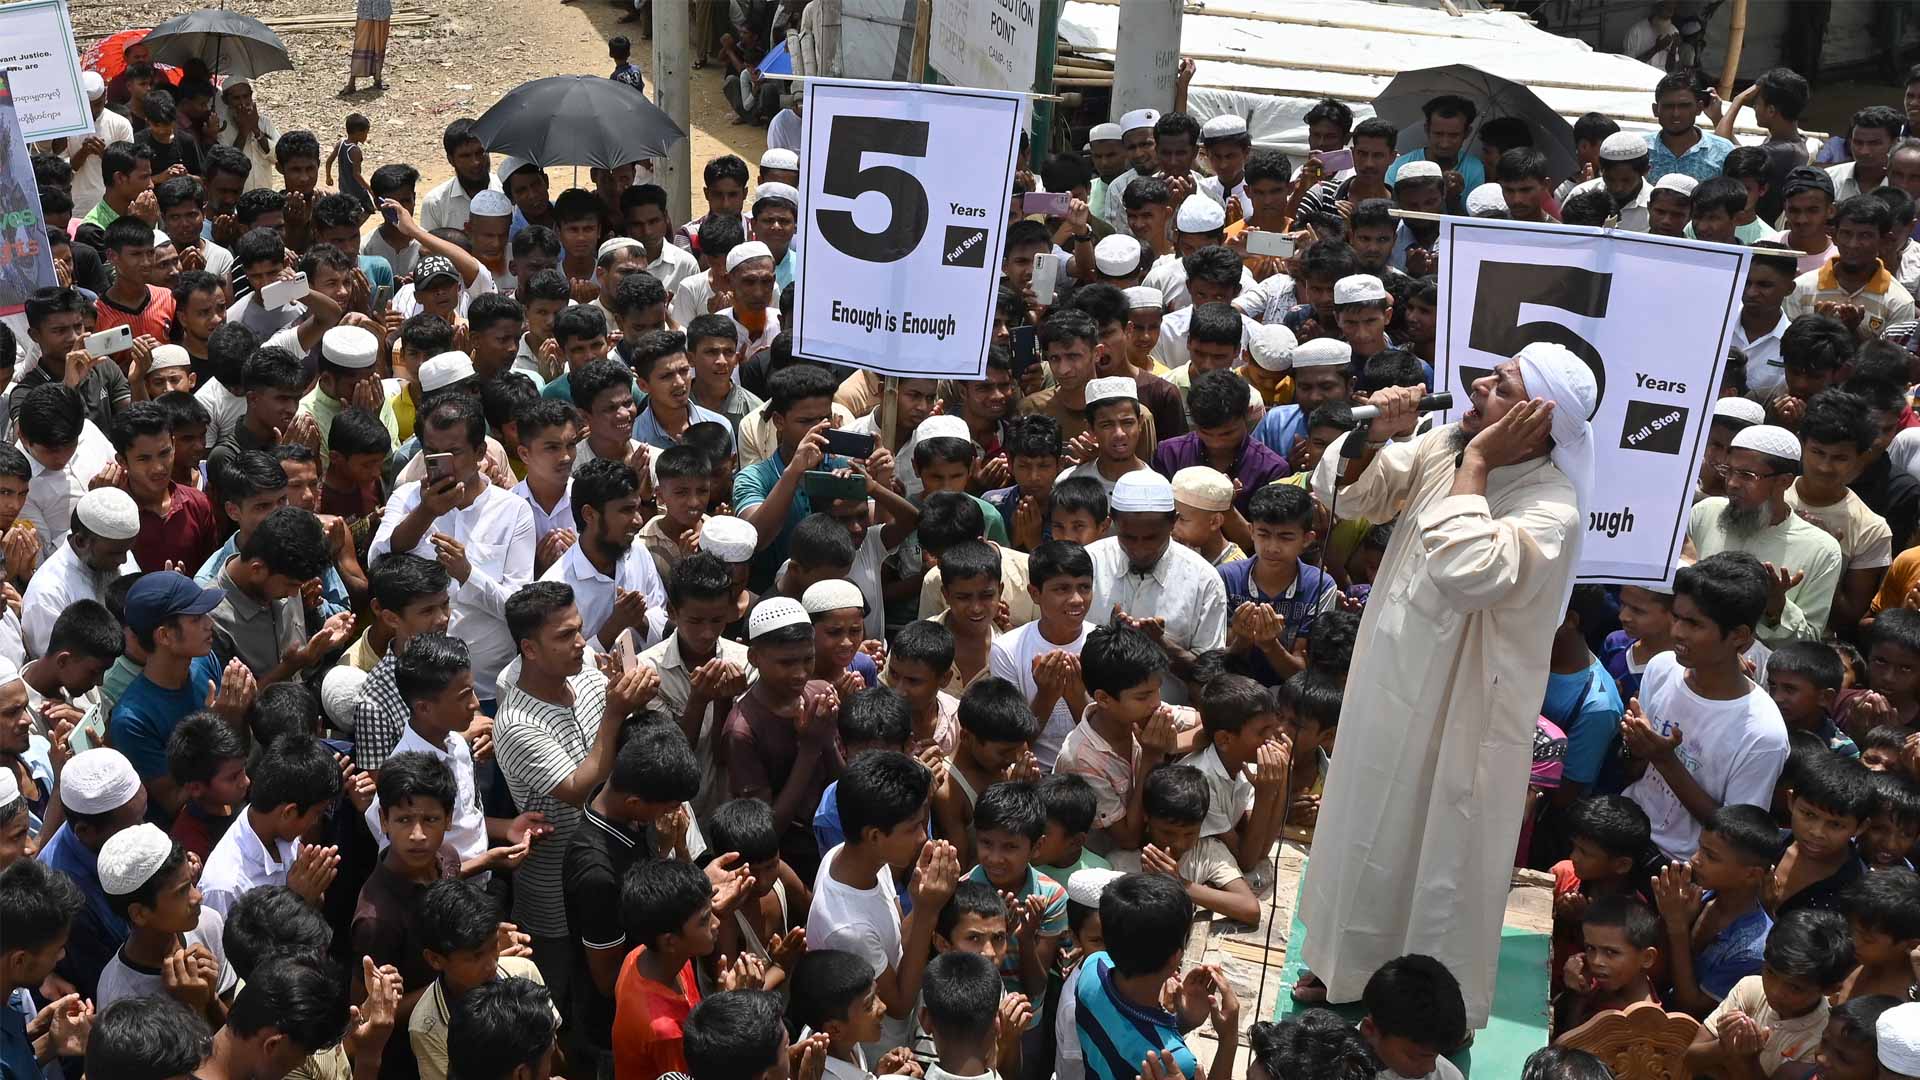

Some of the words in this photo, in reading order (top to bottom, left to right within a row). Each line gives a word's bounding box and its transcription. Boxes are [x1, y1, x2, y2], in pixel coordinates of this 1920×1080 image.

[990, 11, 1016, 46] POINT
[994, 0, 1034, 28] UTION
[816, 115, 930, 263] 5
[950, 202, 986, 218] Years
[946, 246, 964, 262] Full
[962, 231, 983, 249] Stop
[831, 299, 882, 333] Enough
[884, 309, 897, 332] is
[901, 311, 956, 341] Enough
[1459, 260, 1613, 423] 5
[1635, 372, 1687, 394] Years
[1626, 425, 1652, 445] Full
[1650, 410, 1681, 430] Stop
